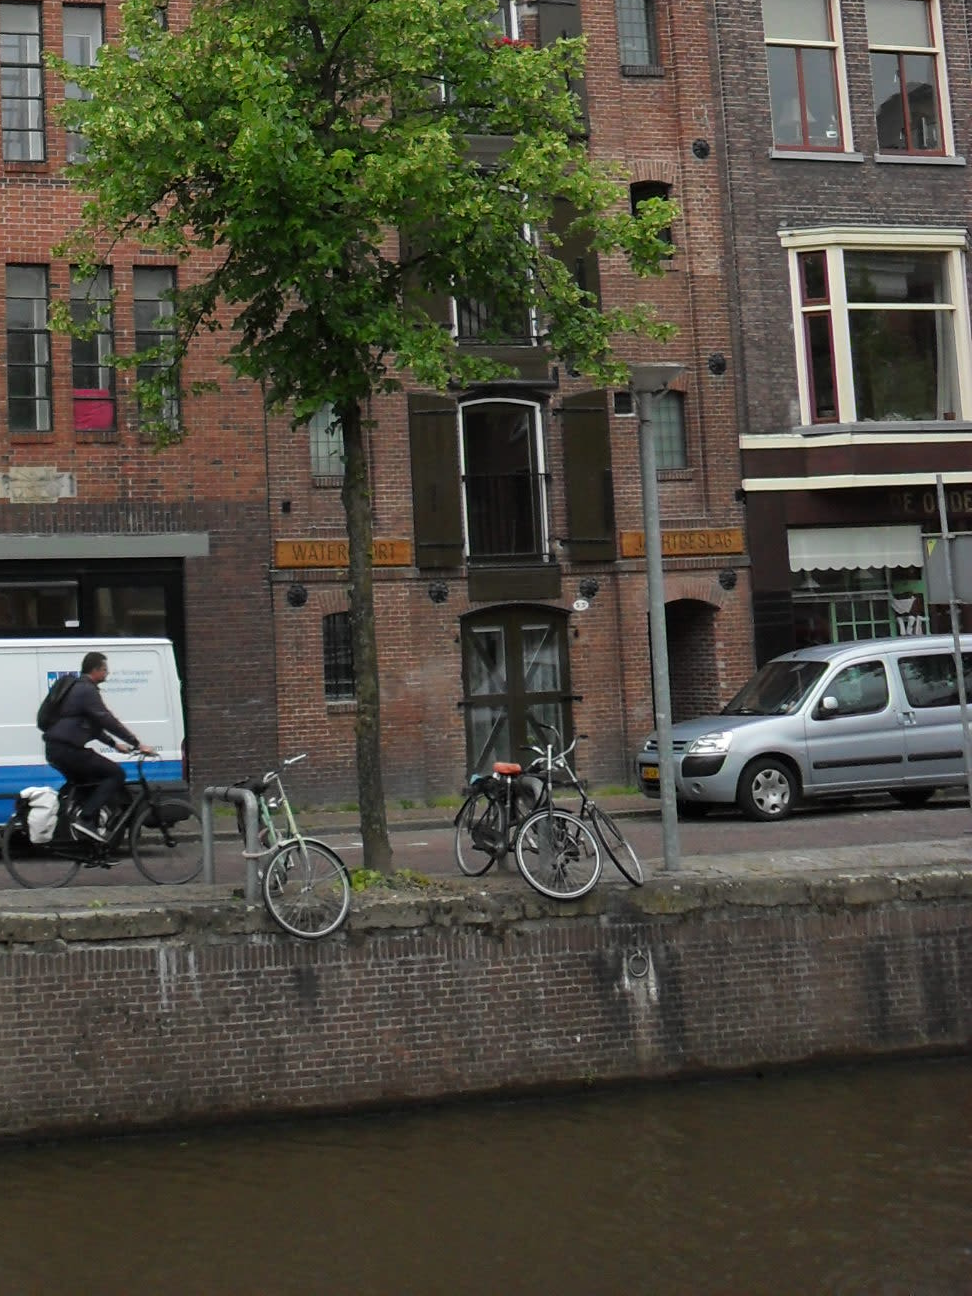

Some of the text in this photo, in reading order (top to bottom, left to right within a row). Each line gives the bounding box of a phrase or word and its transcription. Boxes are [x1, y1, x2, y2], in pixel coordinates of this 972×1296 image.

[923, 489, 972, 513] ODE
[292, 543, 395, 561] WATERRT
[635, 532, 732, 552] JHTBESLAG
